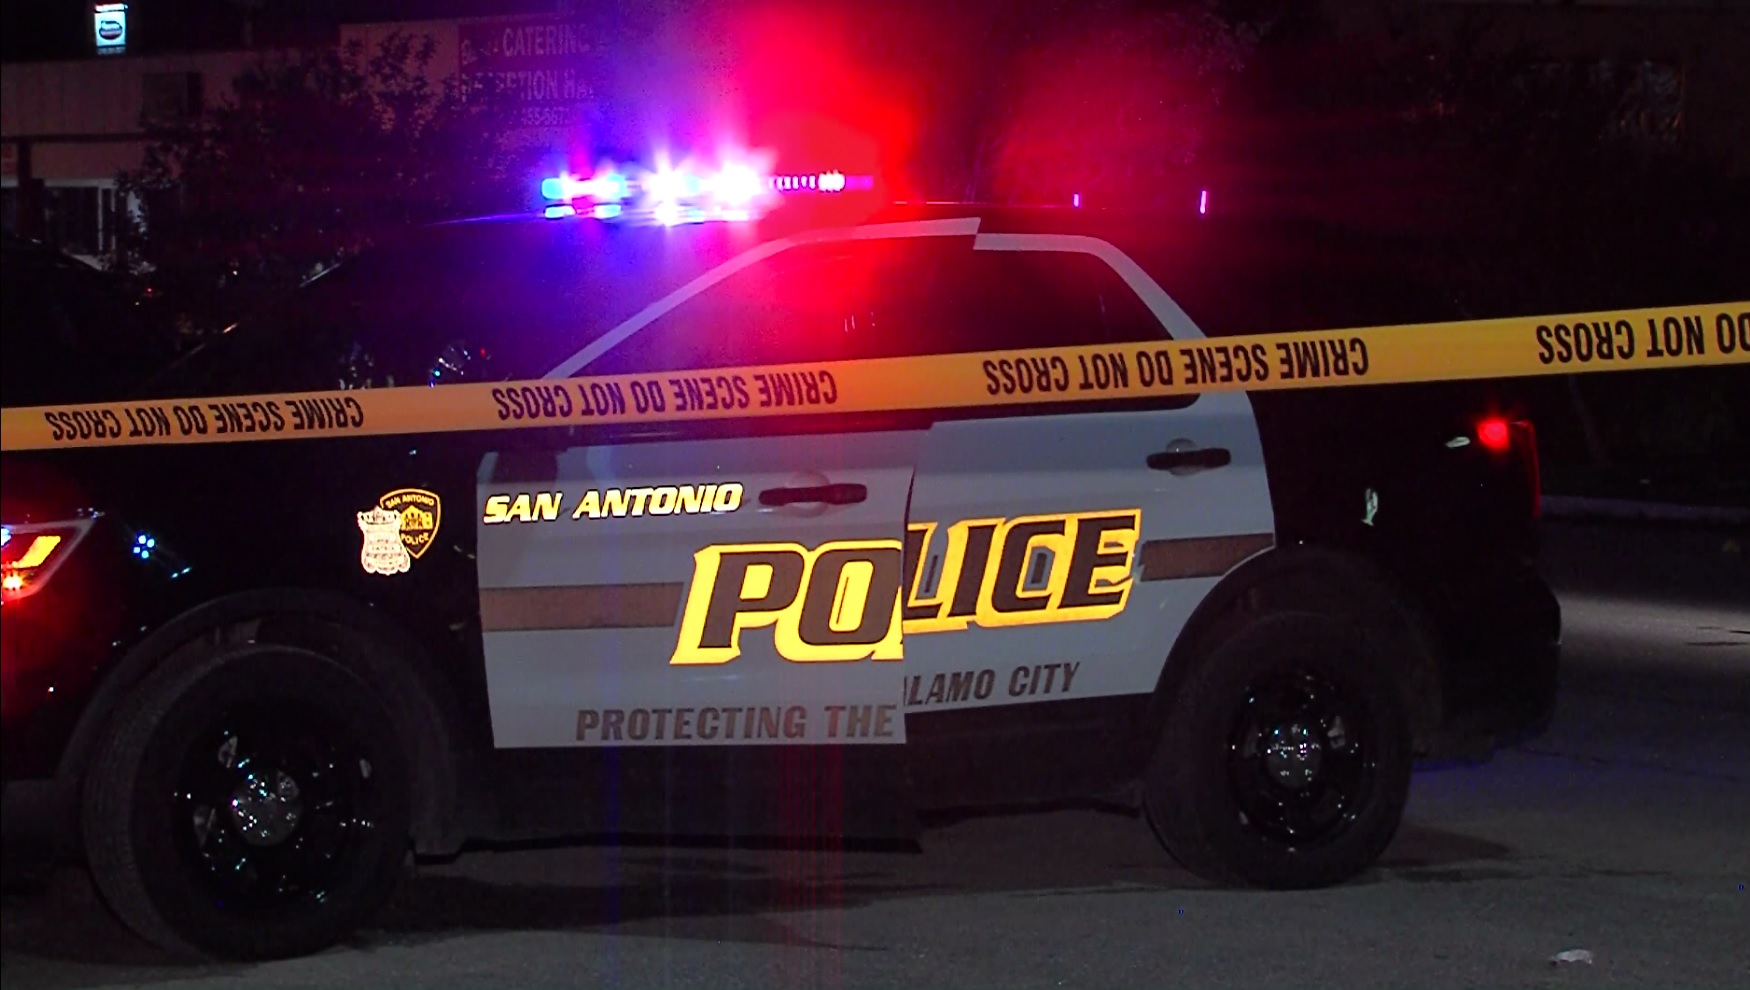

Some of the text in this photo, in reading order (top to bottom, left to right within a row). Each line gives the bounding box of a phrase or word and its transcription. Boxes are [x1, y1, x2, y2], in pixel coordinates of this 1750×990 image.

[1536, 319, 1636, 365] CROSS
[1646, 315, 1705, 358] NOT
[982, 337, 1369, 396] CRIME SCENE DO NOT CROSS
[44, 396, 365, 441] CRIME SCENE DO NOT CROSS
[491, 371, 838, 421] CRIME SCENE DO NOT CROSS
[385, 494, 435, 509] SAN ANTONIO
[482, 482, 744, 524] SAN ANTONIO
[401, 532, 430, 546] POLICE
[575, 661, 1082, 742] PROTECTING THE LAMO CITY
